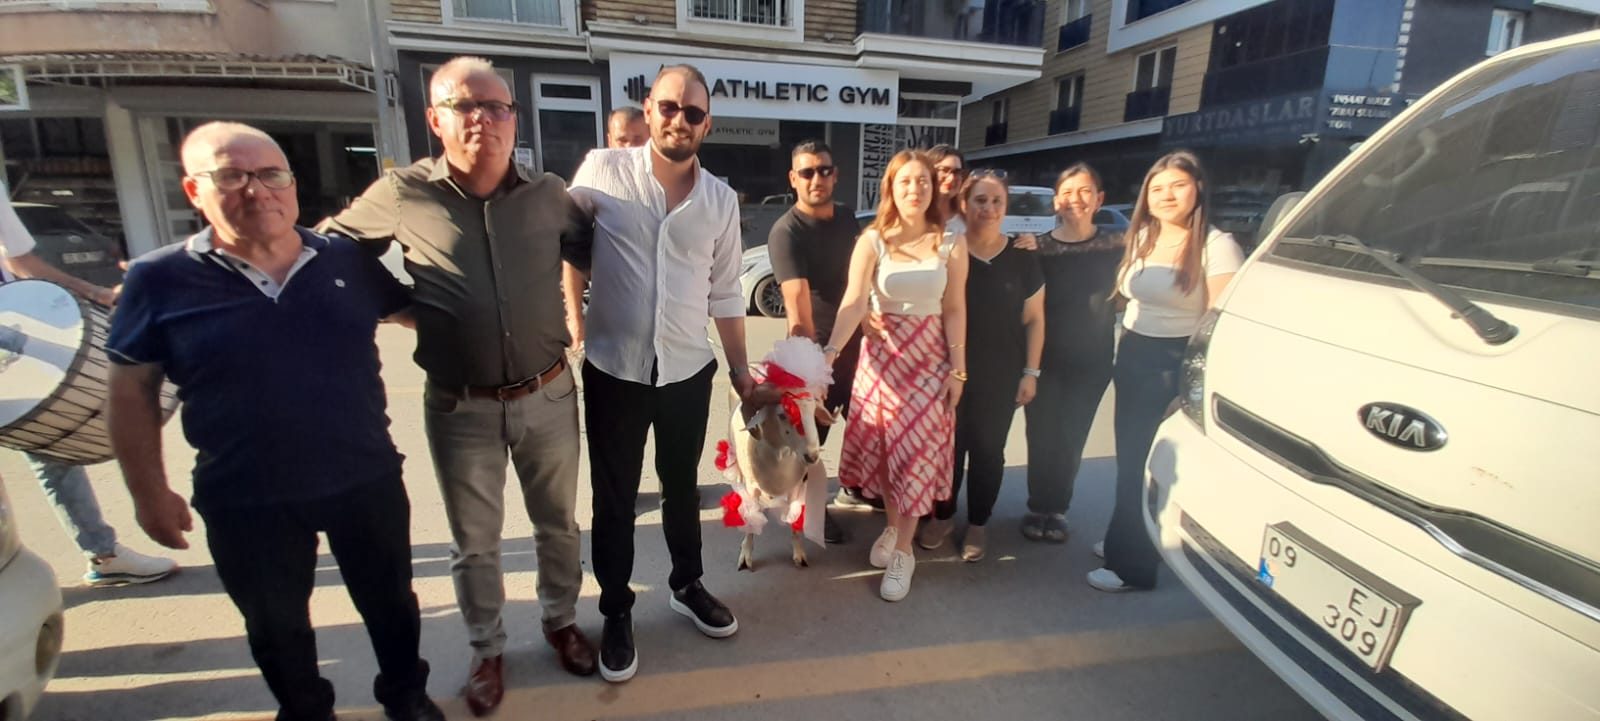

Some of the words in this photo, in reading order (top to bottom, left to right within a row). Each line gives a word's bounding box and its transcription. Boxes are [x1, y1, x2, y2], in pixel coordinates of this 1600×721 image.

[711, 78, 829, 102] ATHLETIC
[838, 85, 891, 106] GYM
[1366, 406, 1426, 447] KIA
[1269, 537, 1298, 568] 09
[1348, 588, 1388, 628] EJ
[1322, 604, 1378, 656] 309
